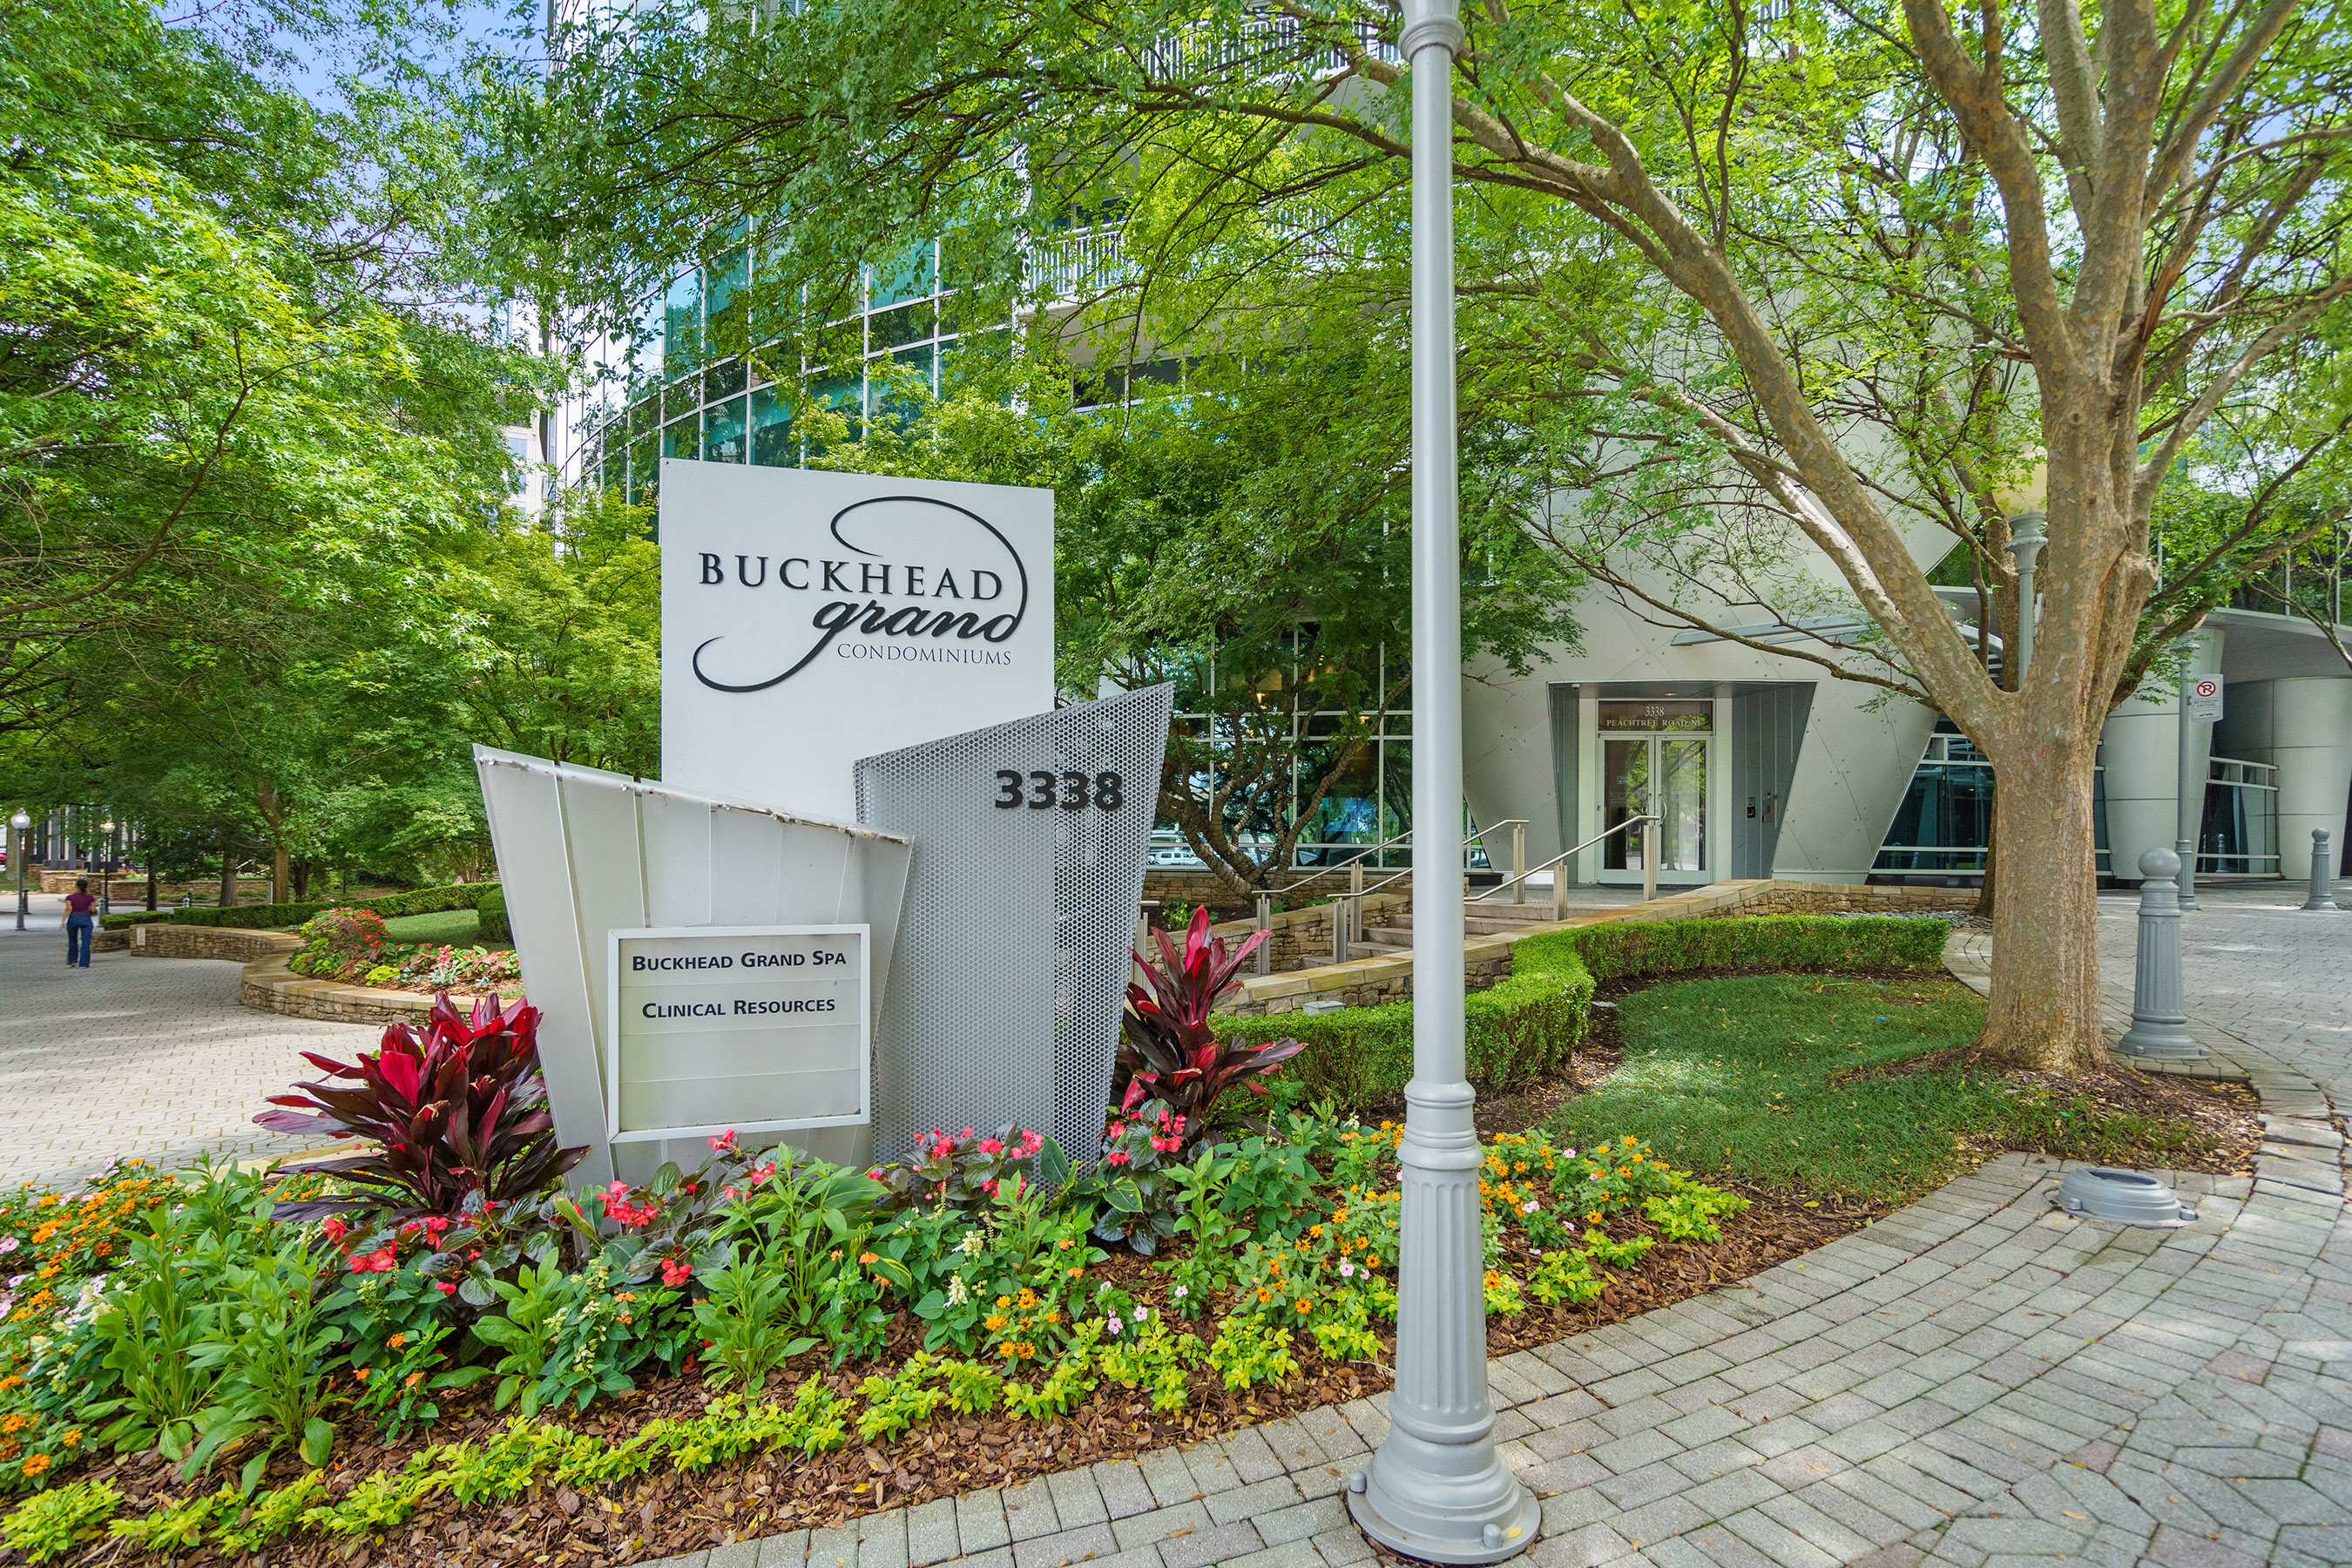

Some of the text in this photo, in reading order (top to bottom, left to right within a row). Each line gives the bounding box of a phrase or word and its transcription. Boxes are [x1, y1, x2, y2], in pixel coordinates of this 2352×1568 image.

[699, 552, 1003, 600] BUCKHEAD
[837, 643, 1011, 666] CONDOMINIUMS
[1645, 706, 1665, 717] 3338
[995, 770, 1124, 812] 3338
[632, 950, 847, 971] BUCKHEAD GRAND SPA
[642, 998, 835, 1019] CLINICAL RESOURCES
